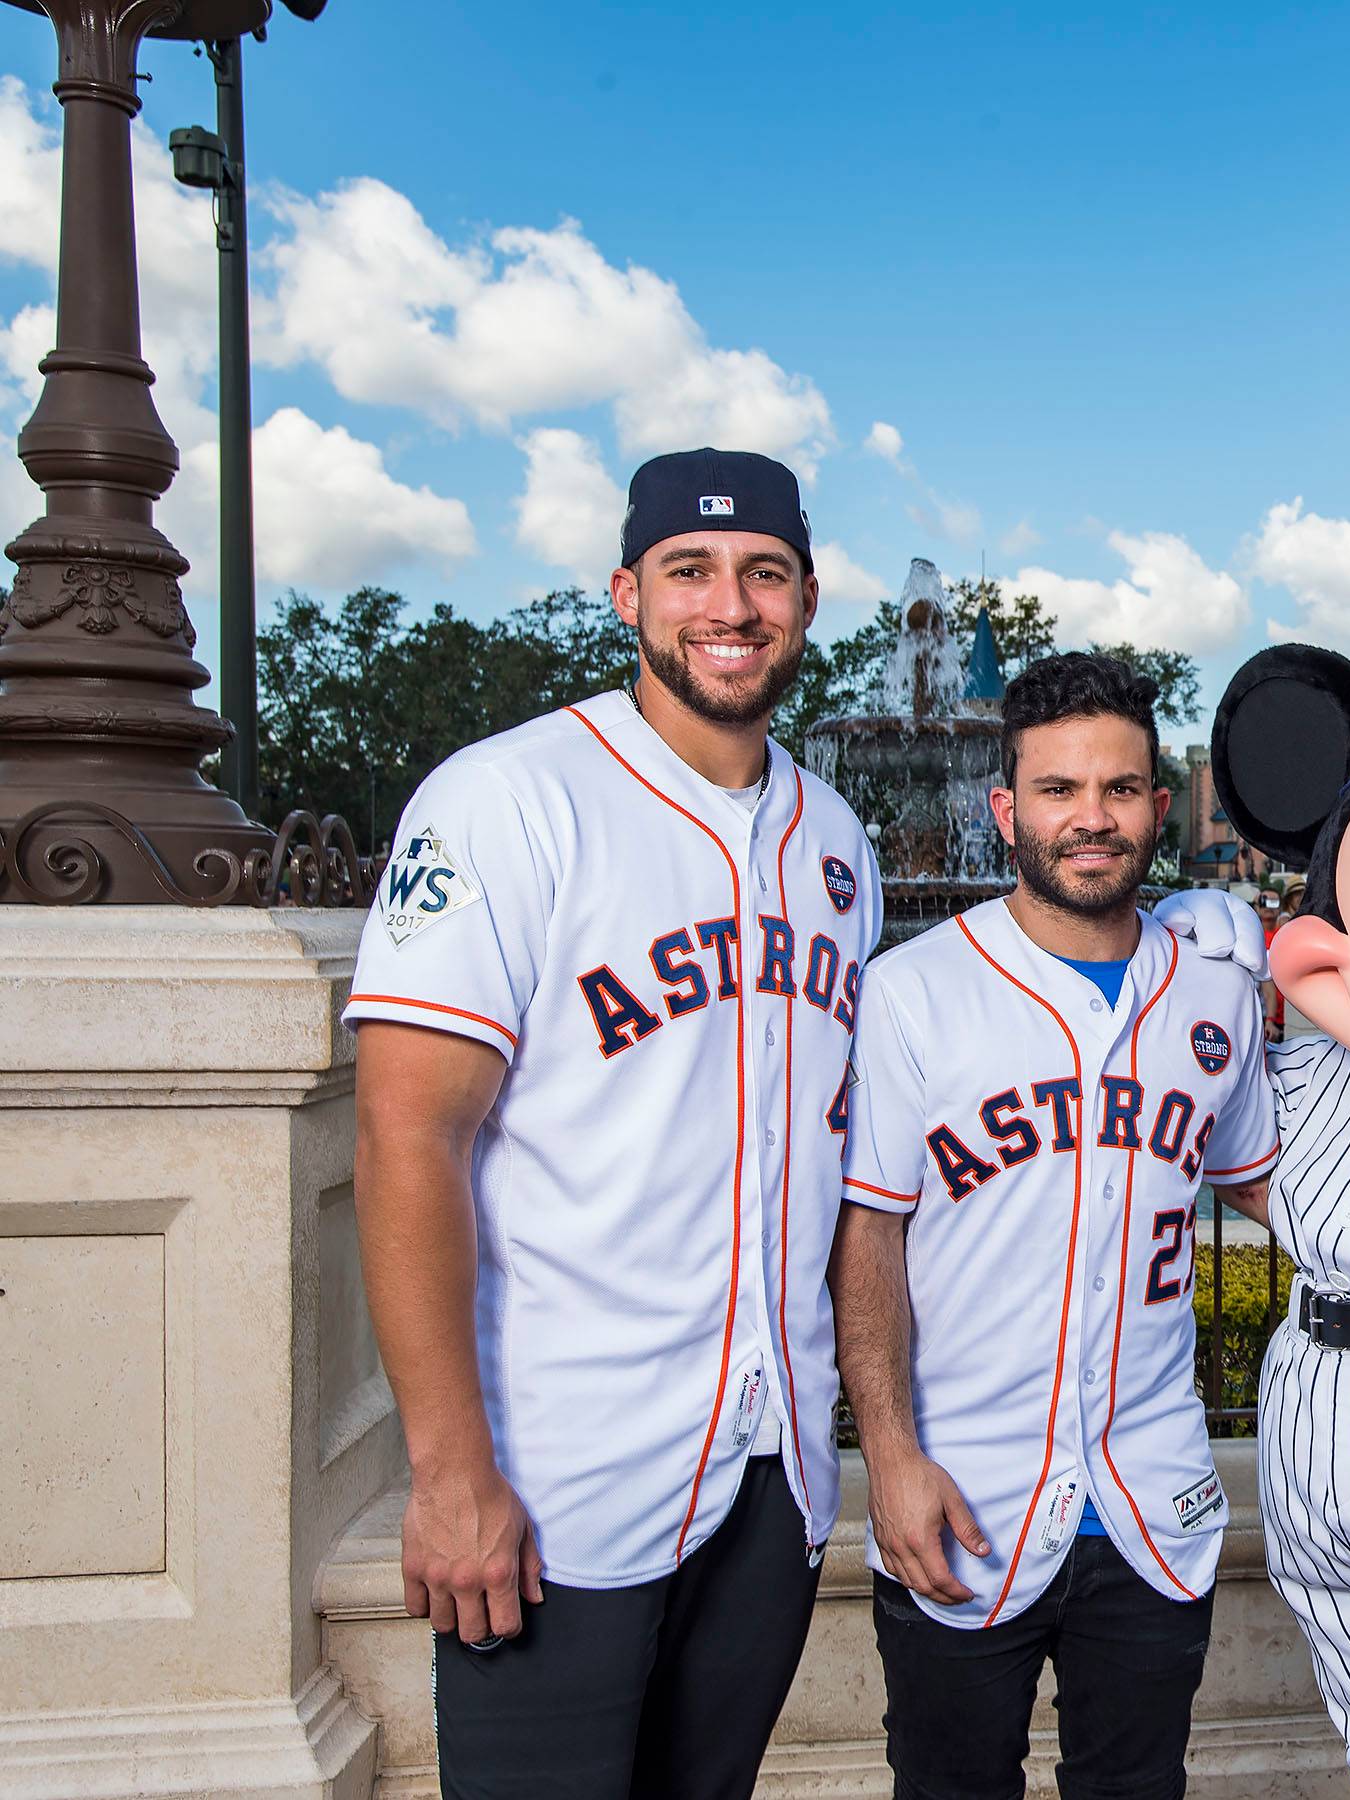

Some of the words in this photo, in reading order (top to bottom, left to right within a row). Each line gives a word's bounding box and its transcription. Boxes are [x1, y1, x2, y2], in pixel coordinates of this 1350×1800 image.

[388, 863, 456, 913] WS
[386, 913, 426, 930] 2017
[1194, 1039, 1228, 1056] STRONG
